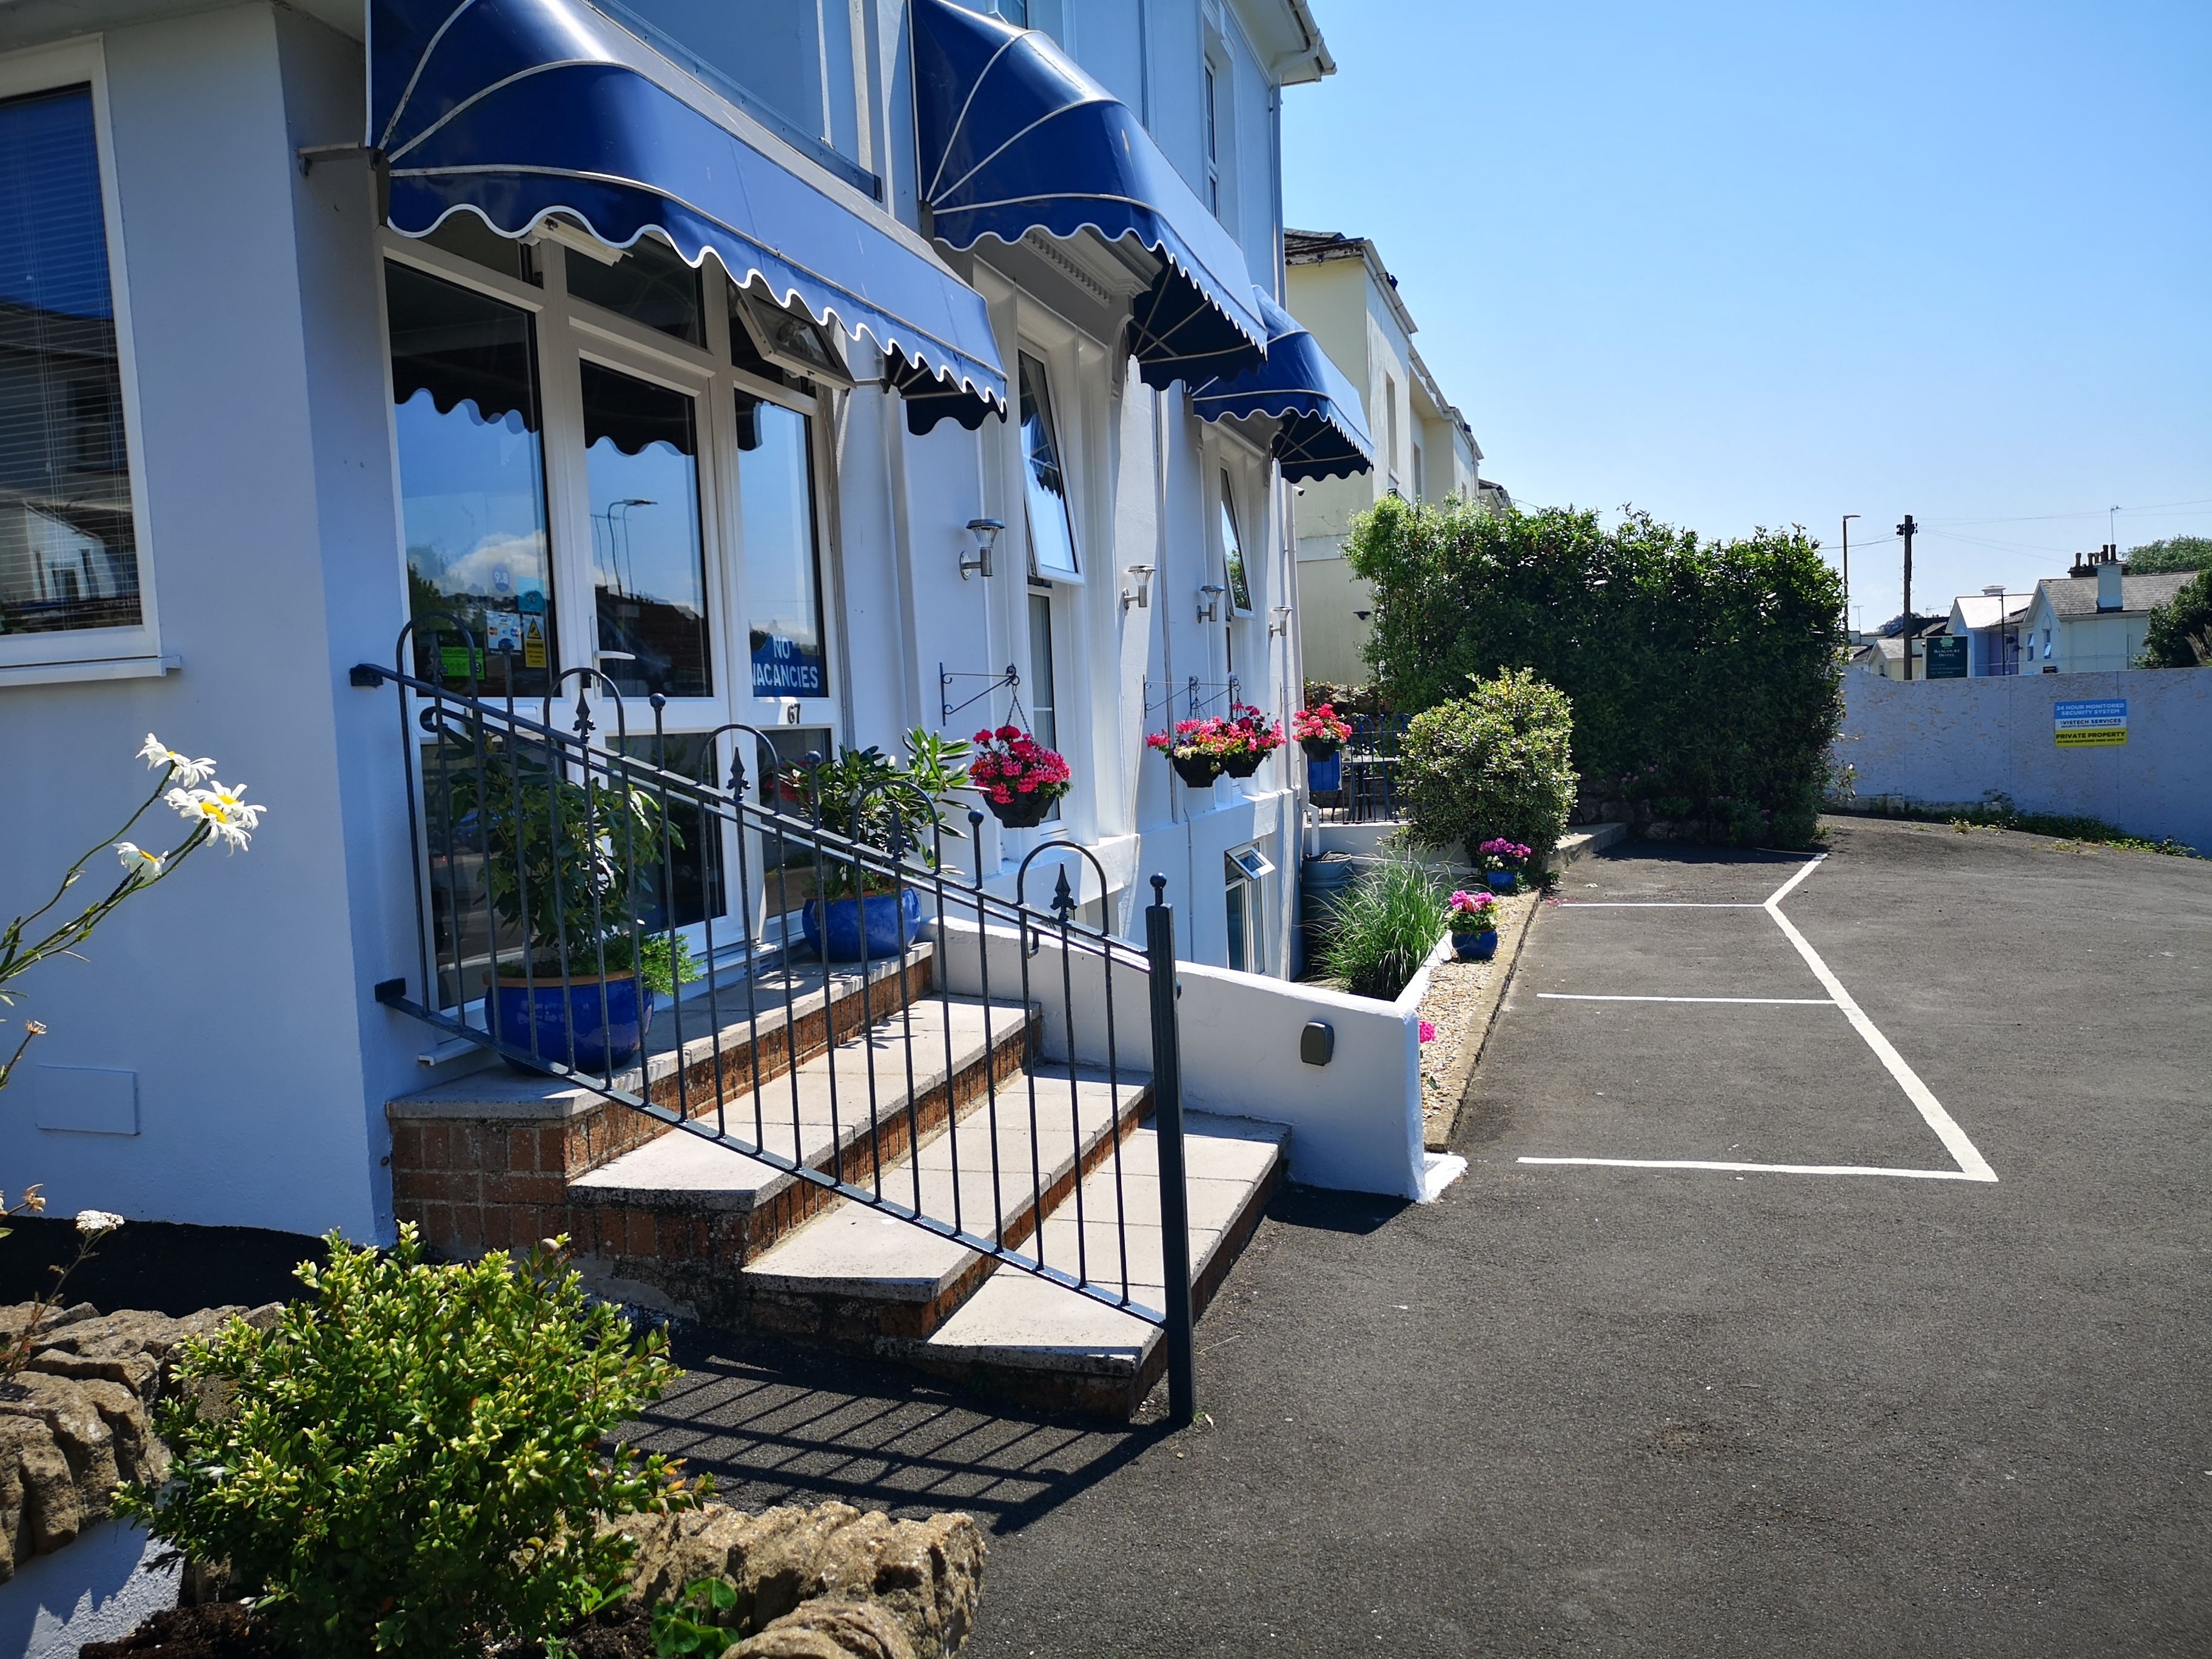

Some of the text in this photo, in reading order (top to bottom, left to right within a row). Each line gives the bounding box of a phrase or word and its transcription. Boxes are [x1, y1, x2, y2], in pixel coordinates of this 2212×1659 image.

[494, 571, 509, 583] 9.8
[773, 635, 791, 659] NO
[787, 703, 801, 724] 67
